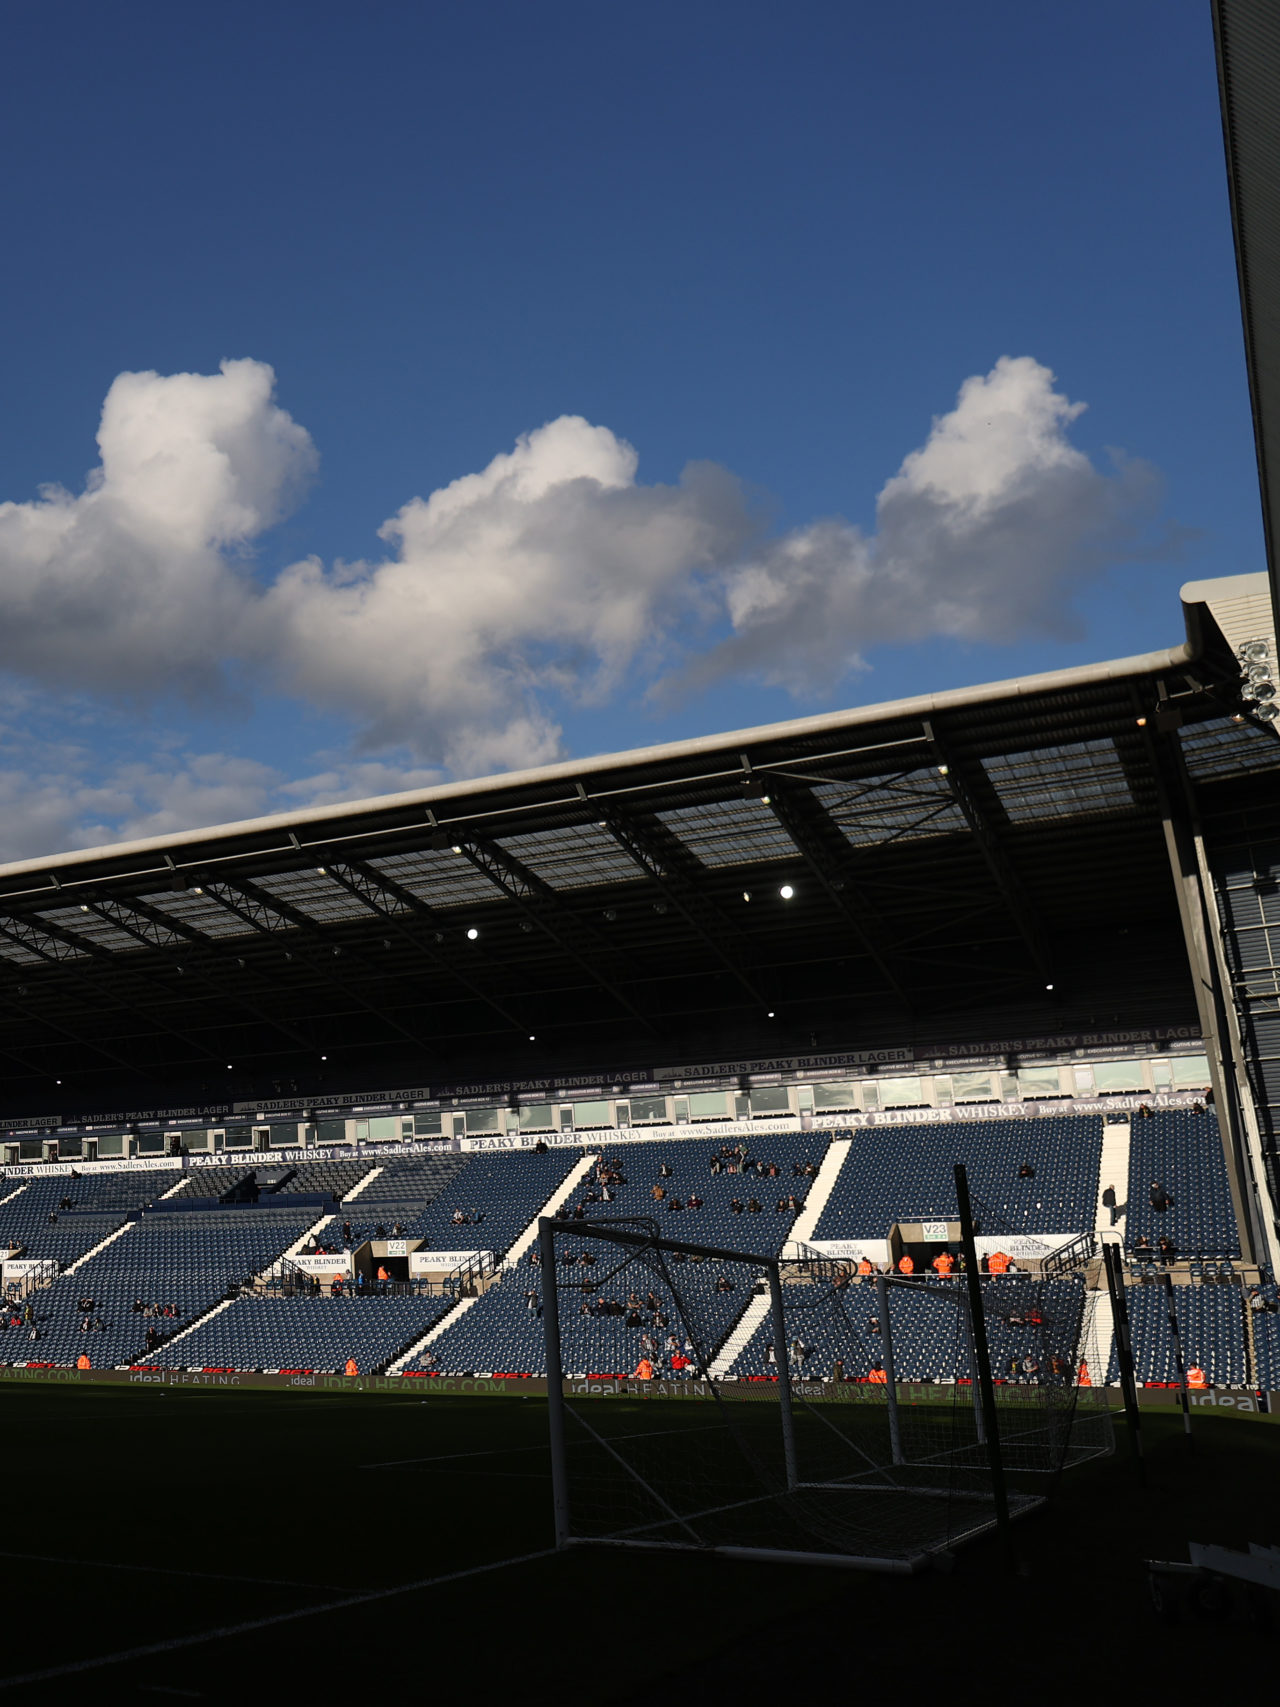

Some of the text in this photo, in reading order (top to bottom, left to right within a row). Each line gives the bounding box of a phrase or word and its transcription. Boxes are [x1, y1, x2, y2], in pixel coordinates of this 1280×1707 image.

[949, 1026, 1201, 1055] SADLER'S PEAKY BLINDER LAGE
[684, 1064, 747, 1077] SADLER'S
[750, 1060, 793, 1072] PEAKY
[798, 1055, 855, 1068] BLINDER
[859, 1050, 906, 1063] LAGER
[456, 1072, 647, 1095] SADLER'S PEAKY BLINDER LAGER
[257, 1090, 424, 1110] SADLER'S PEAKY BLINDER LAGER
[82, 1105, 228, 1123] SADLER'S PEAKY BLINDER LAGER
[811, 1104, 1028, 1128] PEAKY BLINDER WHISKEY
[30, 1118, 57, 1126] LAGER
[680, 1122, 790, 1135] www.SadlersAles.com
[471, 1130, 642, 1150] PEAKY BLINDER WHISKEY
[362, 1144, 452, 1157] www.SadlersAles.com
[189, 1150, 333, 1167] PEAKY BLINDER WHISKEY
[36, 1164, 75, 1175] WHISKEY
[100, 1161, 174, 1172] www.SadlersAles.com
[924, 1224, 946, 1234] V23
[389, 1242, 405, 1250] V22
[130, 1371, 240, 1385] ideal HEATING
[291, 1376, 316, 1386] ideal
[323, 1376, 506, 1392] IDEALHEATINGCOM
[572, 1380, 619, 1394] ideal
